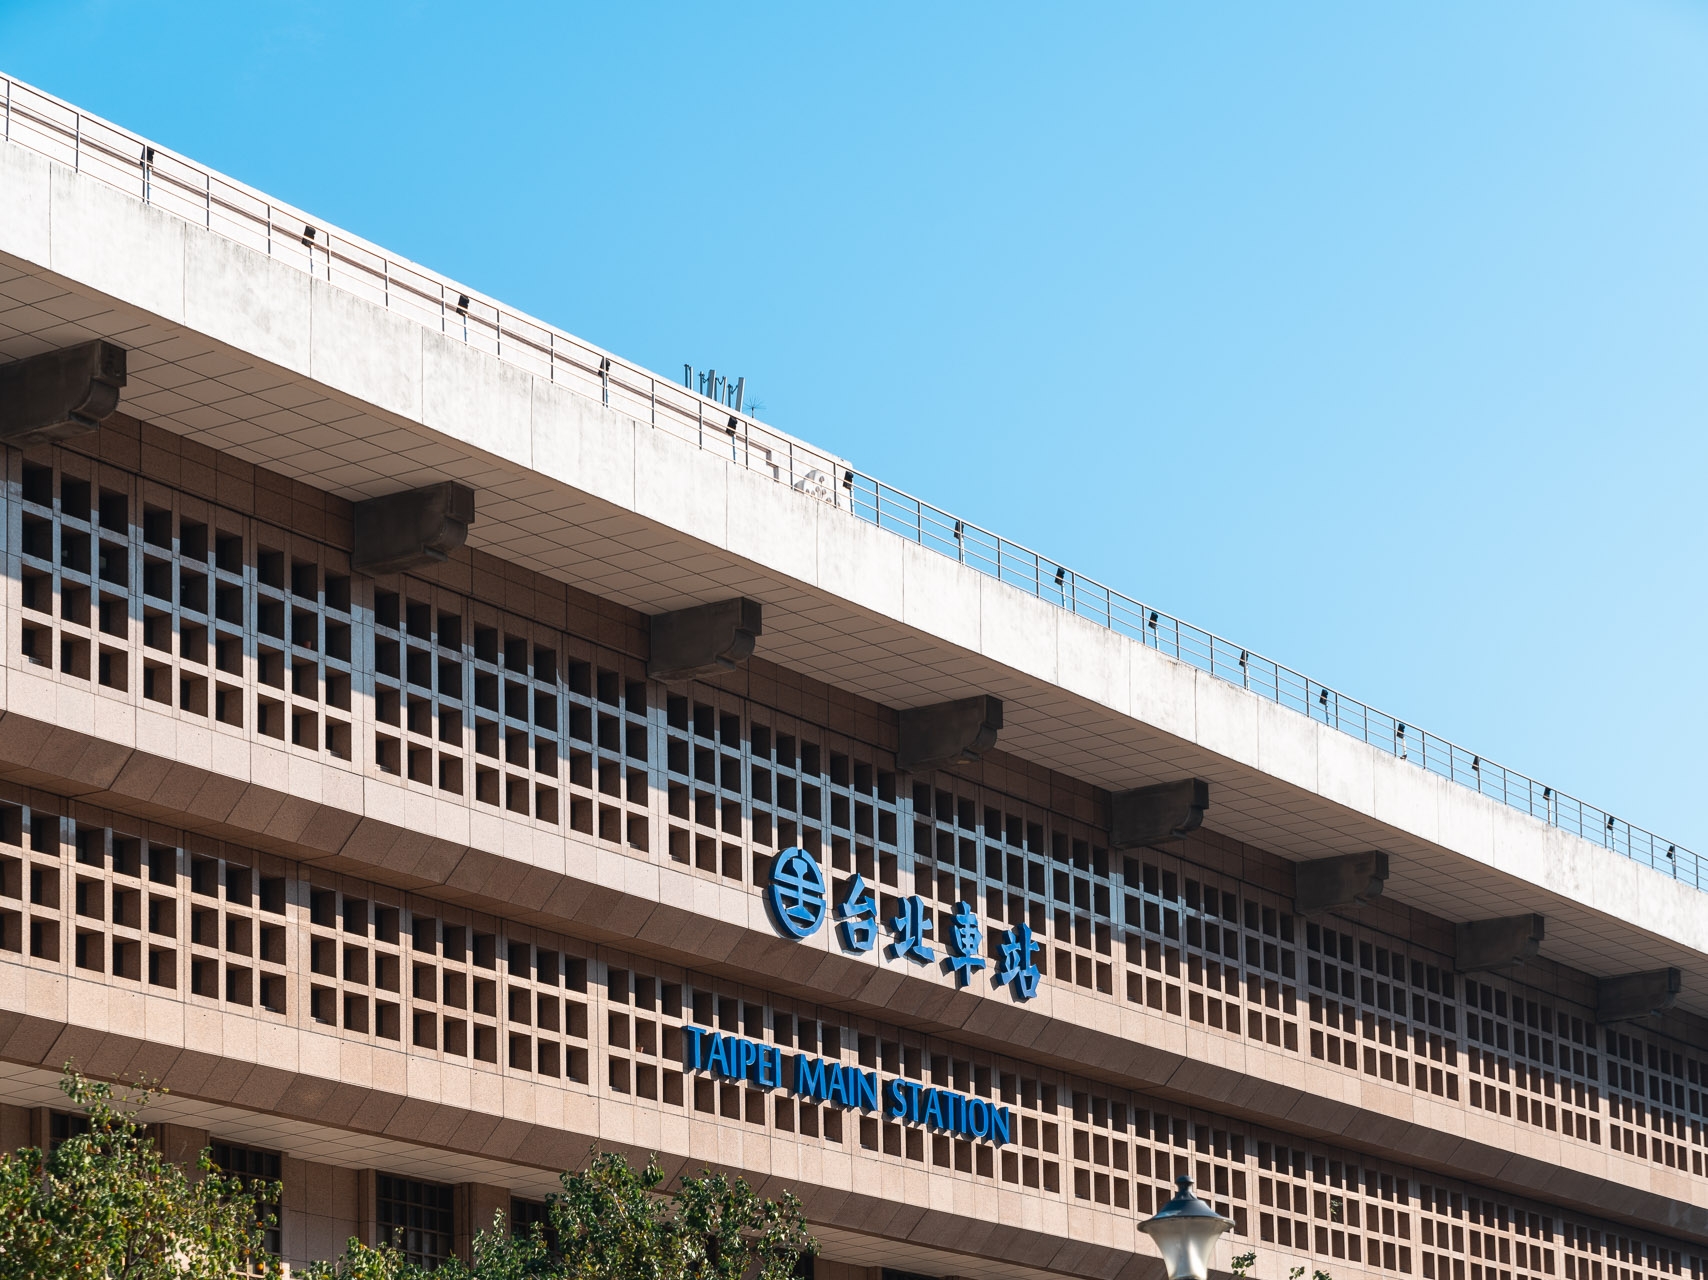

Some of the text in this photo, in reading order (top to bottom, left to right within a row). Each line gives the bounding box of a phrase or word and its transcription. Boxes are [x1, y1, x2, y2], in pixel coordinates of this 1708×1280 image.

[838, 873, 1040, 998] 台北車站
[683, 1025, 1010, 1144] TAIPEI MAIN STATION
